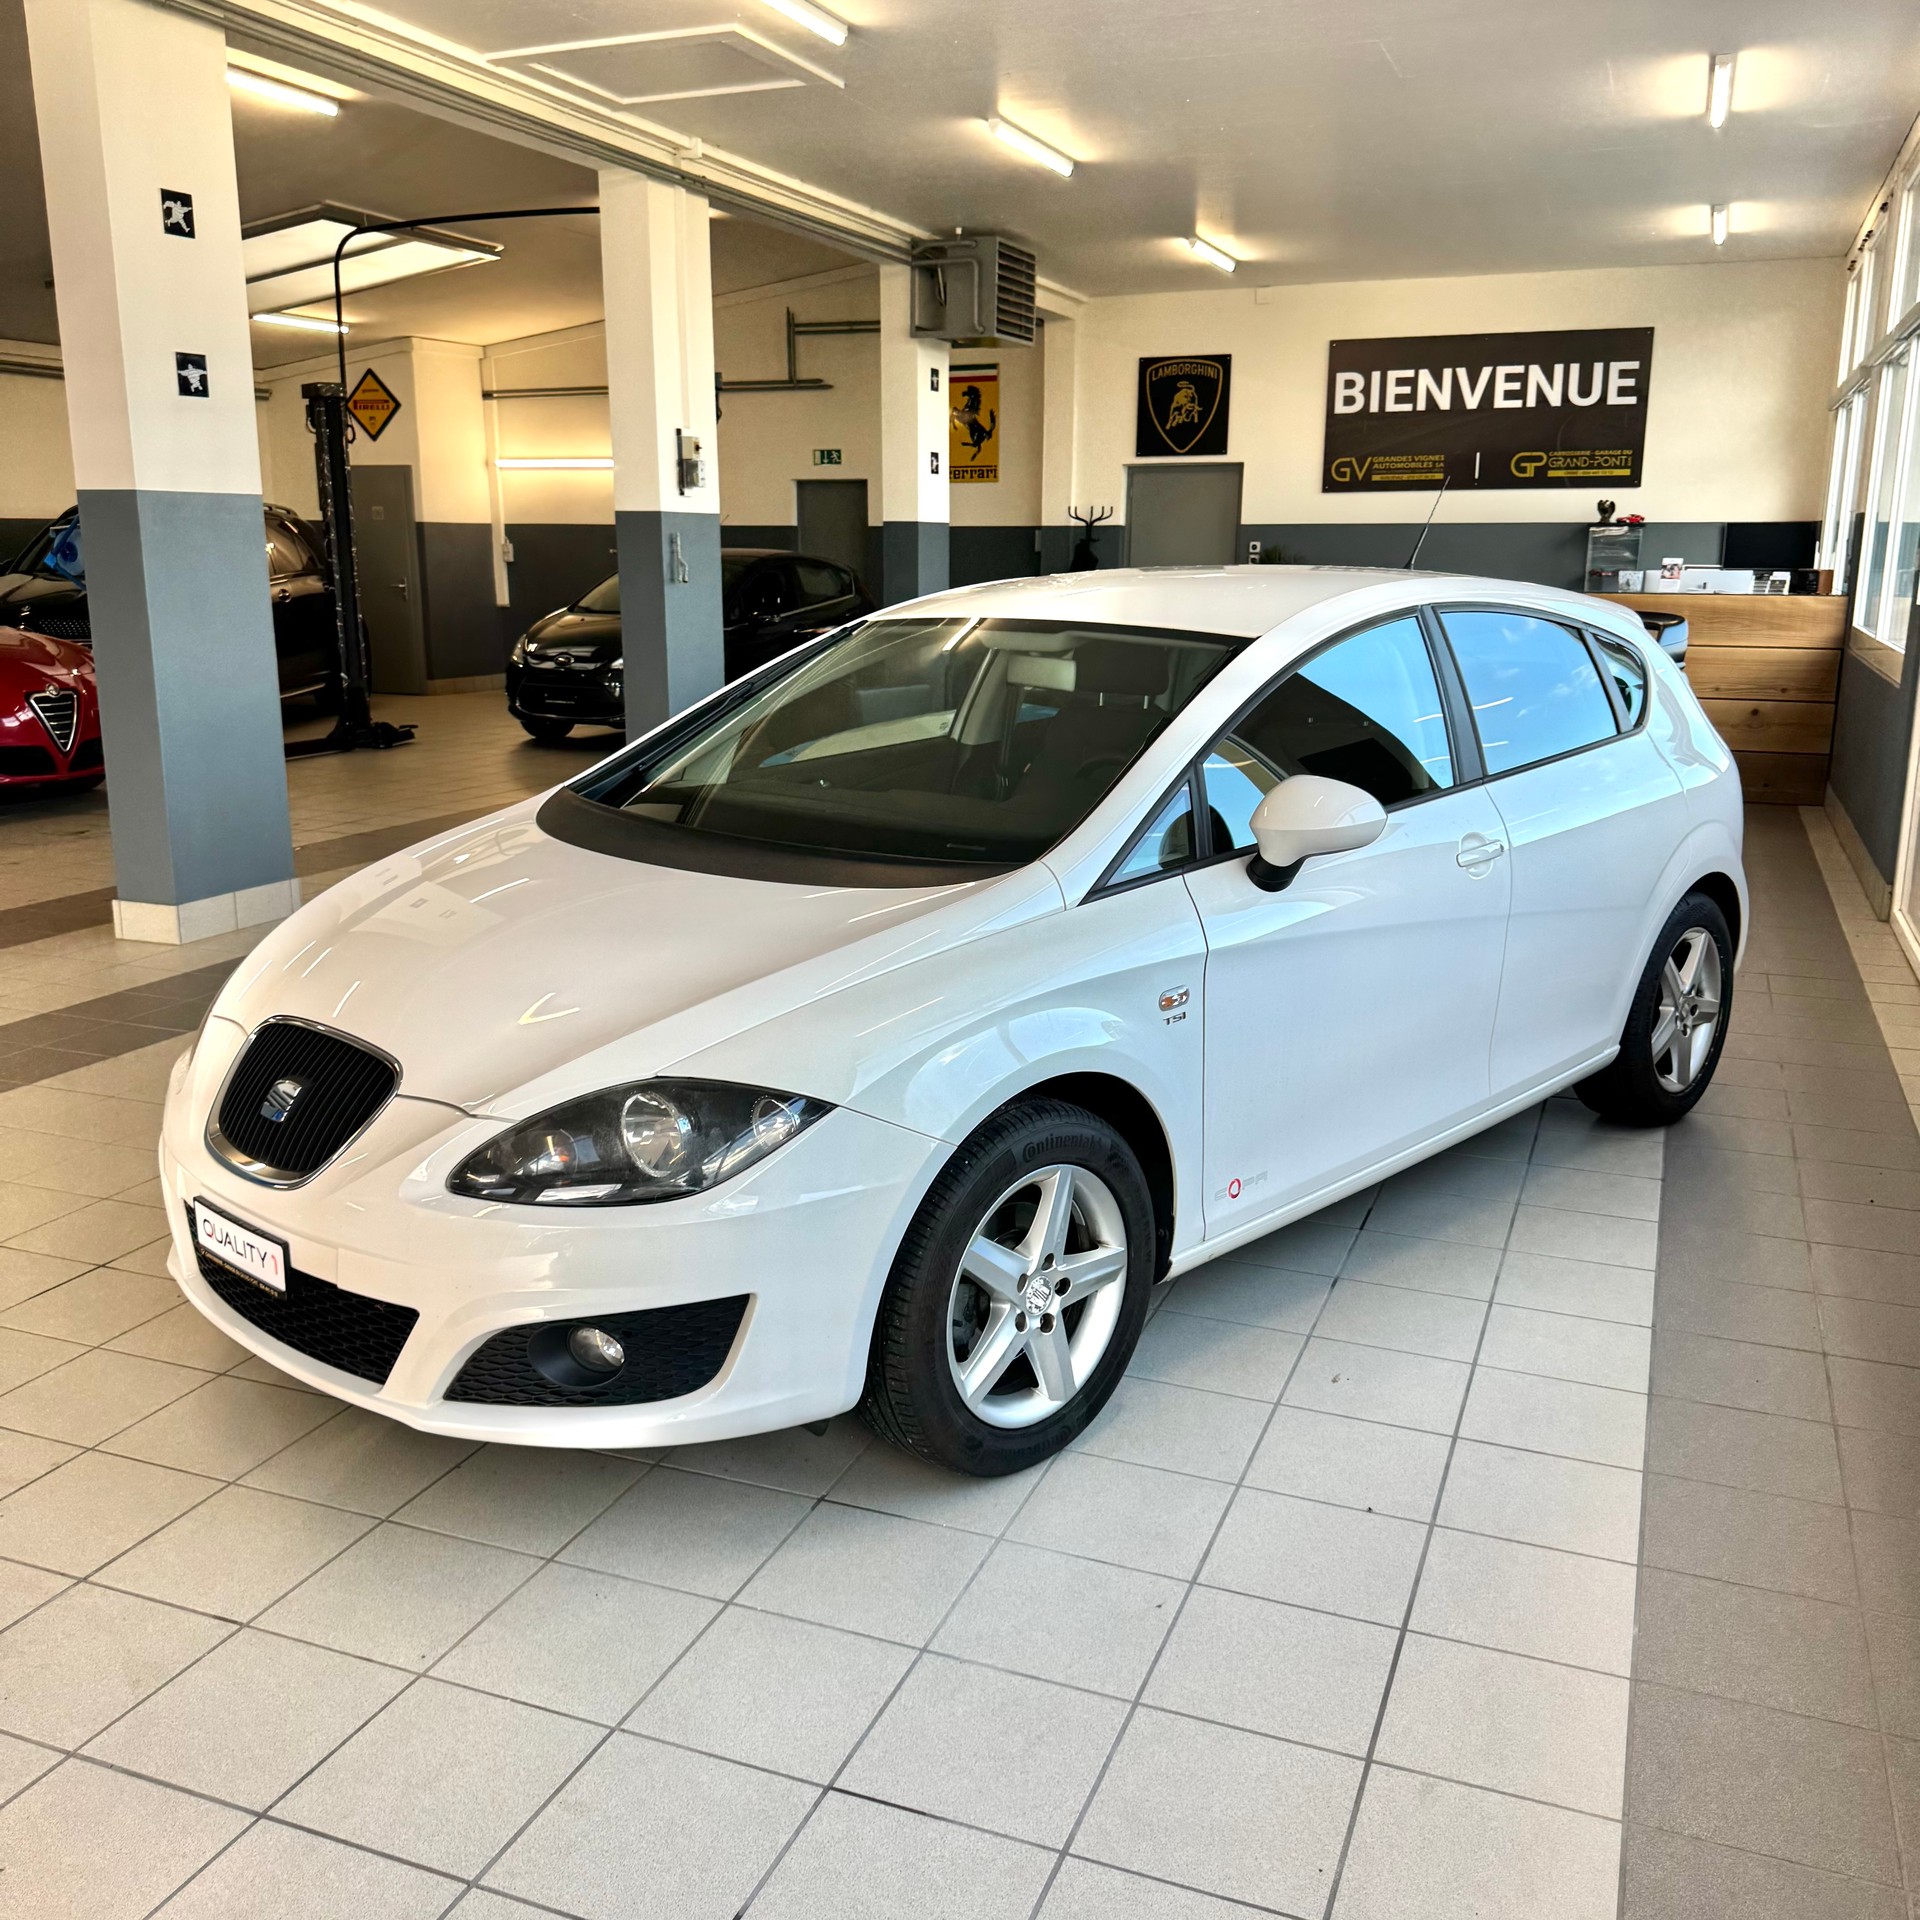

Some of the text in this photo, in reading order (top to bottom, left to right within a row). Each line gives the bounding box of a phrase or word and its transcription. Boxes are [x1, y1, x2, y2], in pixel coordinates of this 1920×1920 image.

[1152, 363, 1218, 381] LAMBORGHINI
[1334, 361, 1640, 414] BIENVENUE
[353, 399, 390, 410] PIRELLI
[1331, 456, 1372, 482] GV
[1162, 1011, 1187, 1026] TSI
[1022, 1132, 1096, 1164] Continental
